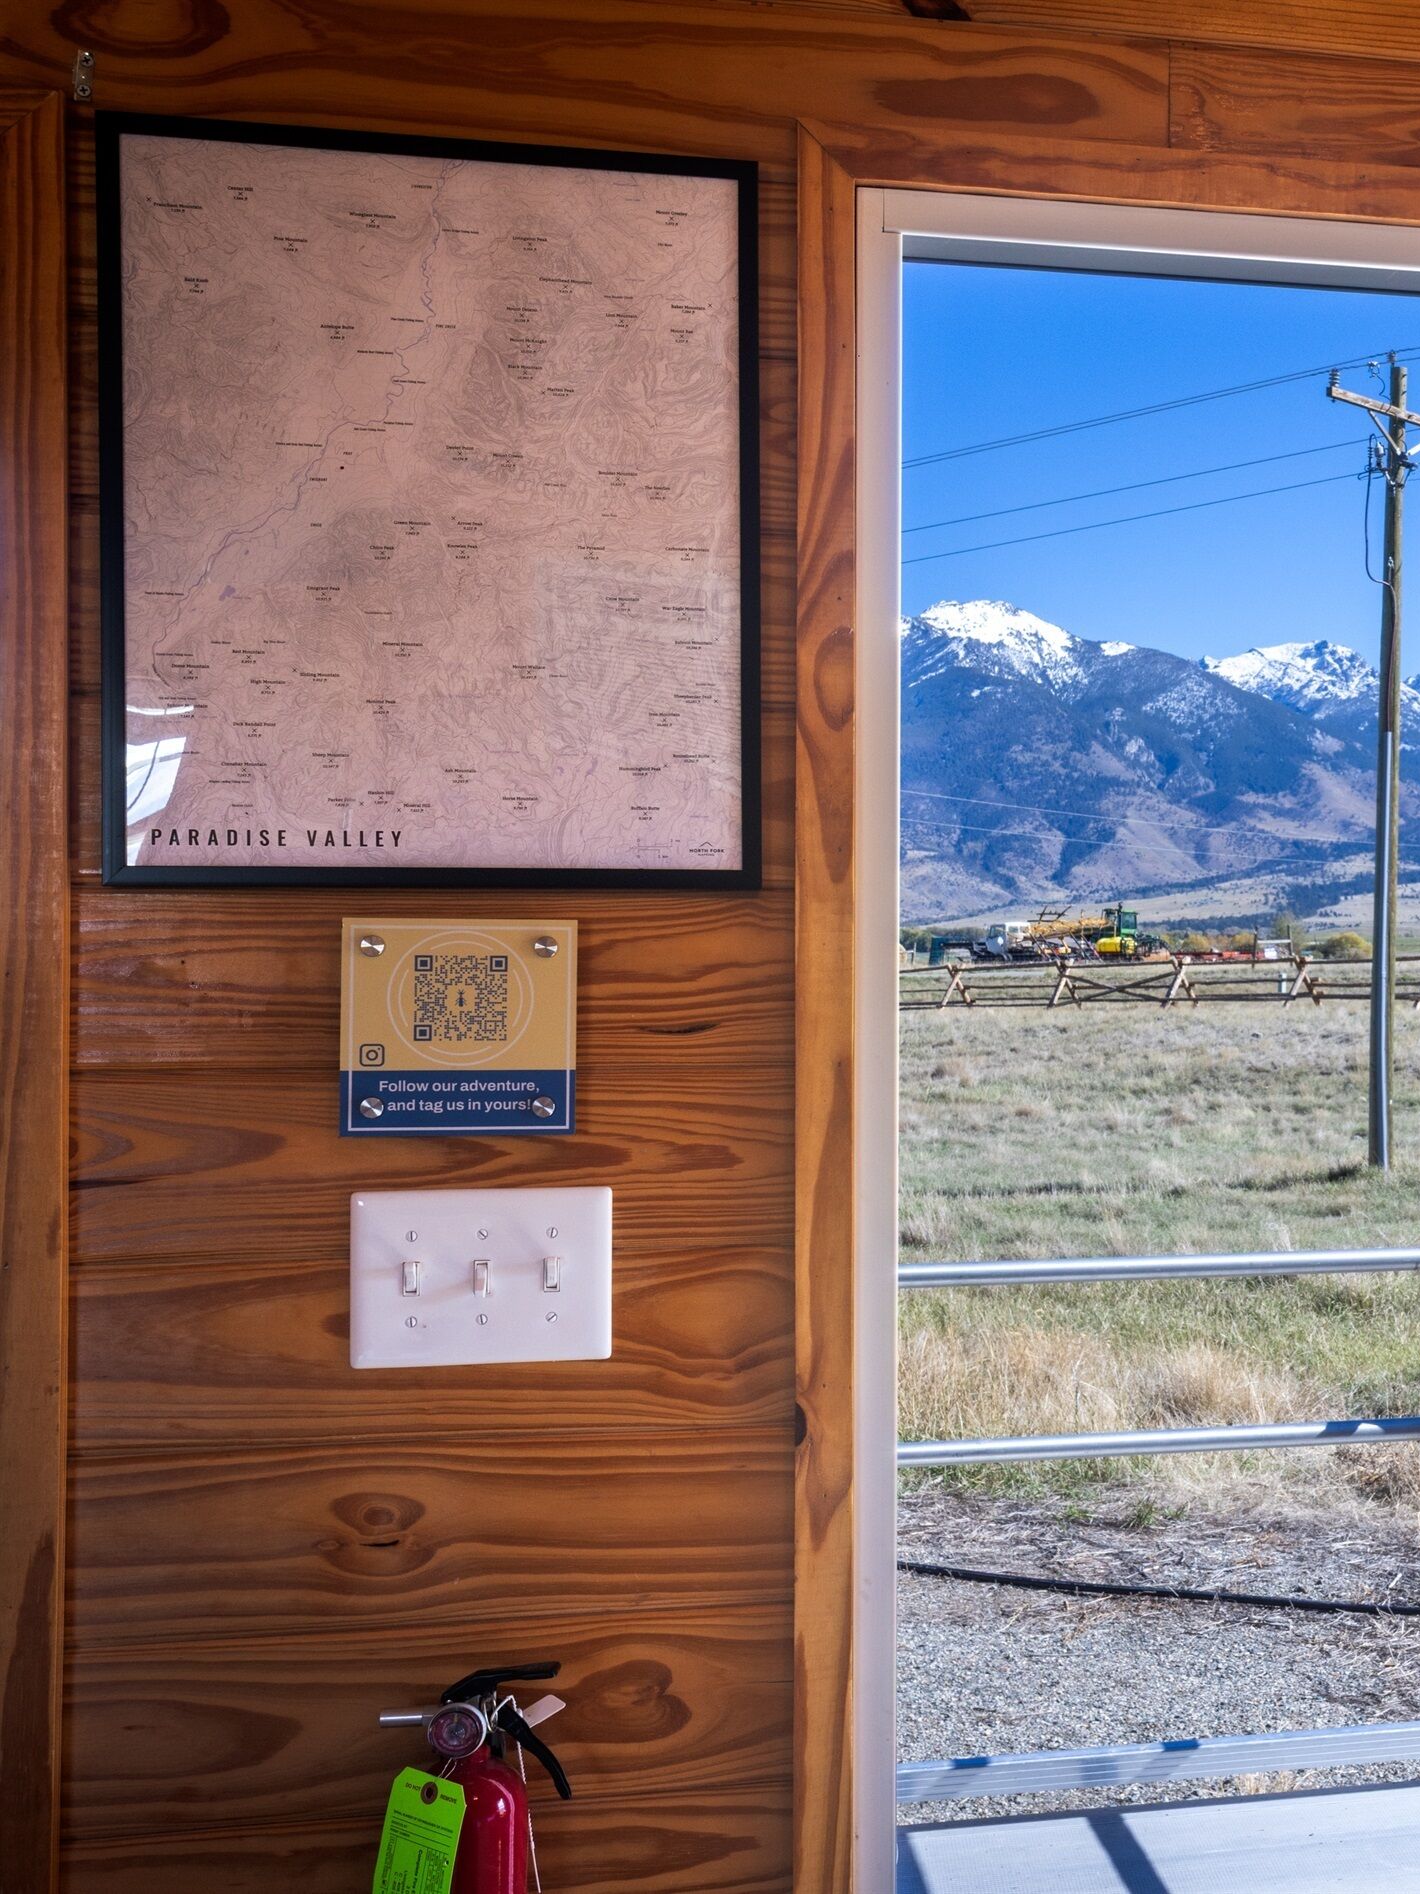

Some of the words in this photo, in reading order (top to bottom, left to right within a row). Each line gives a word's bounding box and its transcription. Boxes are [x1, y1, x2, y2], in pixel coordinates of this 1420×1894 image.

[151, 828, 287, 847] PARADISE
[306, 830, 402, 848] VALLEY
[379, 1080, 429, 1092] Follow
[432, 1083, 457, 1092] our
[460, 1081, 540, 1094] adventure,
[387, 1100, 416, 1111] and
[419, 1101, 444, 1113] tag
[446, 1102, 465, 1111] us
[468, 1099, 480, 1111] in
[484, 1100, 531, 1113] yours!
